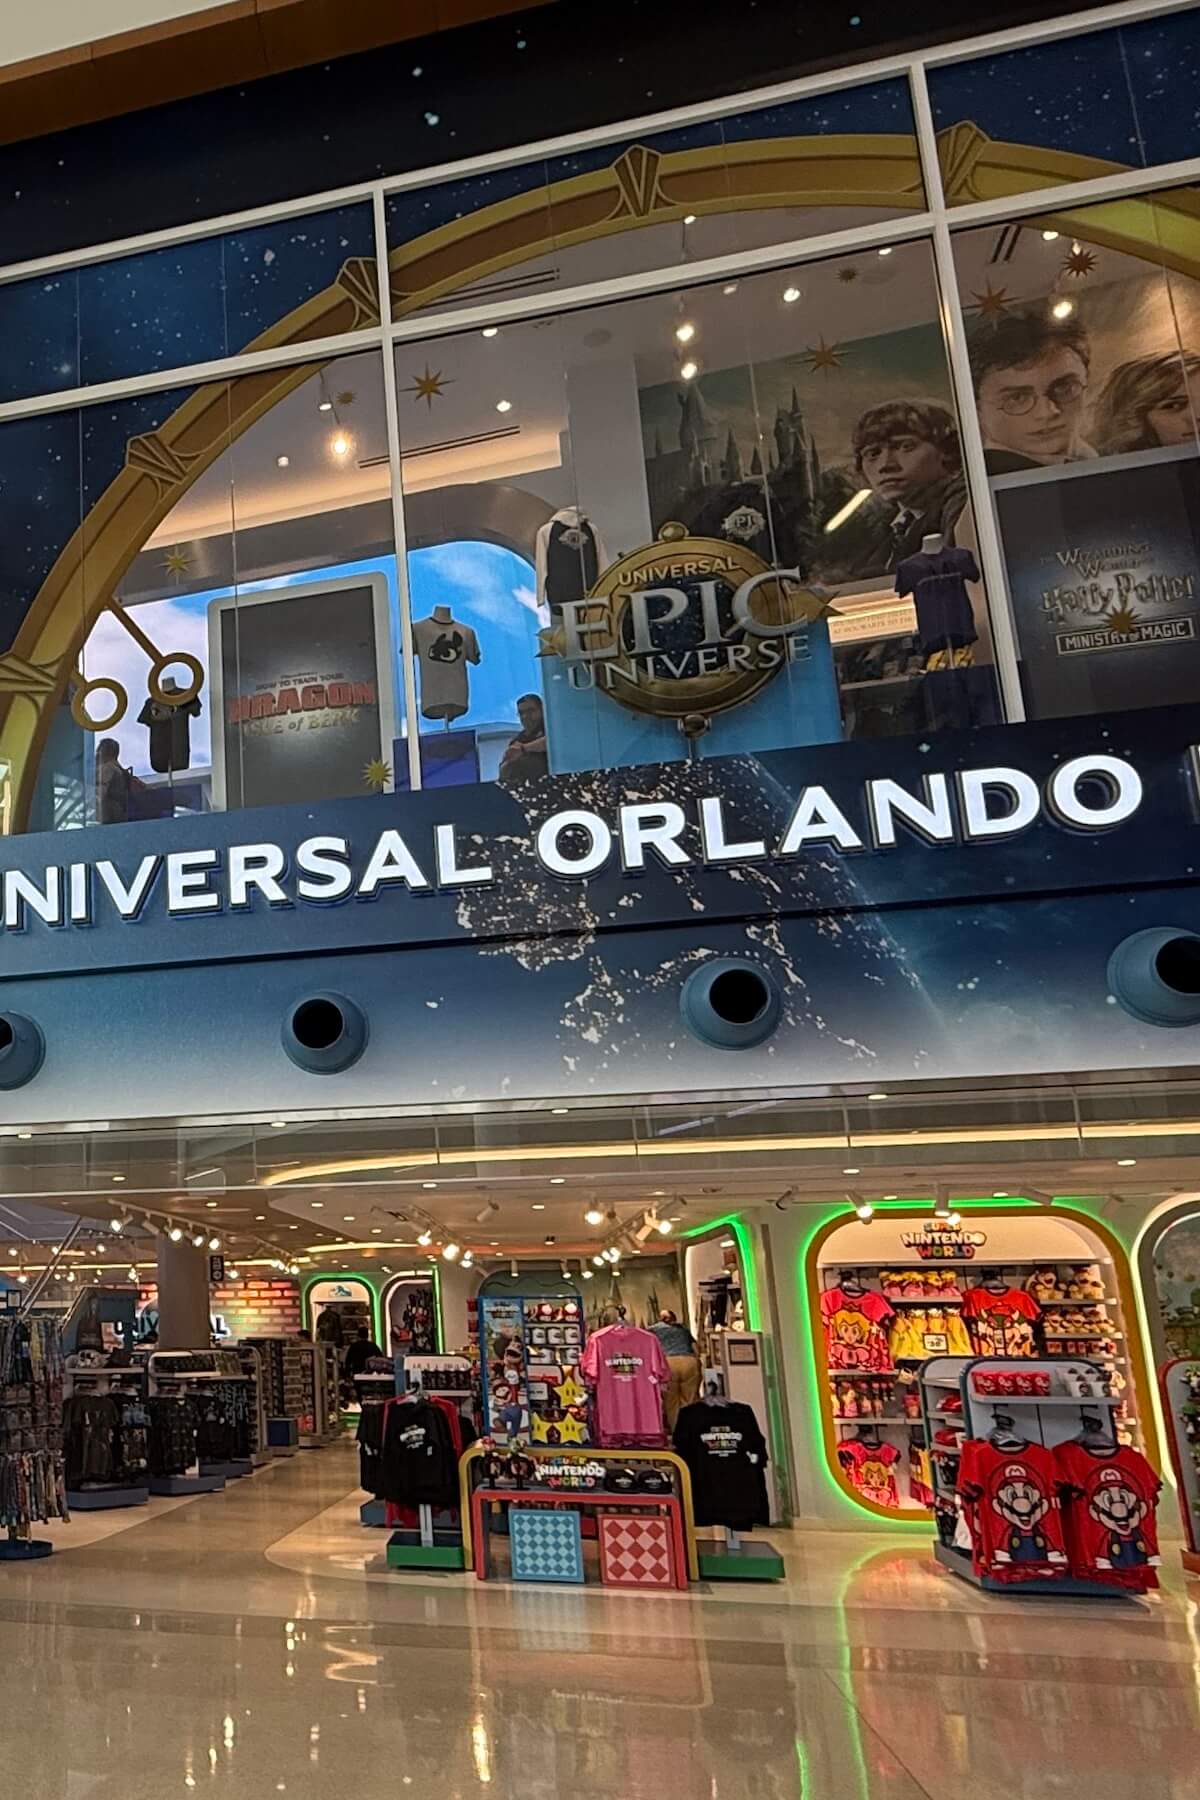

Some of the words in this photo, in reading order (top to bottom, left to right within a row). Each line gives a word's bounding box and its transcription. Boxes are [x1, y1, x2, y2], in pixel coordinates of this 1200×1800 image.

[618, 556, 741, 586] UNIVERSAL
[561, 565, 810, 661] EPIC
[1065, 631, 1128, 650] MINISTRY
[1141, 622, 1187, 641] MAGIC
[568, 634, 813, 690] UNIVERSE
[228, 681, 376, 723] DRAGON
[536, 754, 1143, 876] ORLANDO
[901, 1231, 987, 1248] NINTENDO
[917, 1244, 976, 1260] WORLD
[535, 1461, 606, 1481] NINTENDO
[547, 1476, 596, 1488] WORLD
